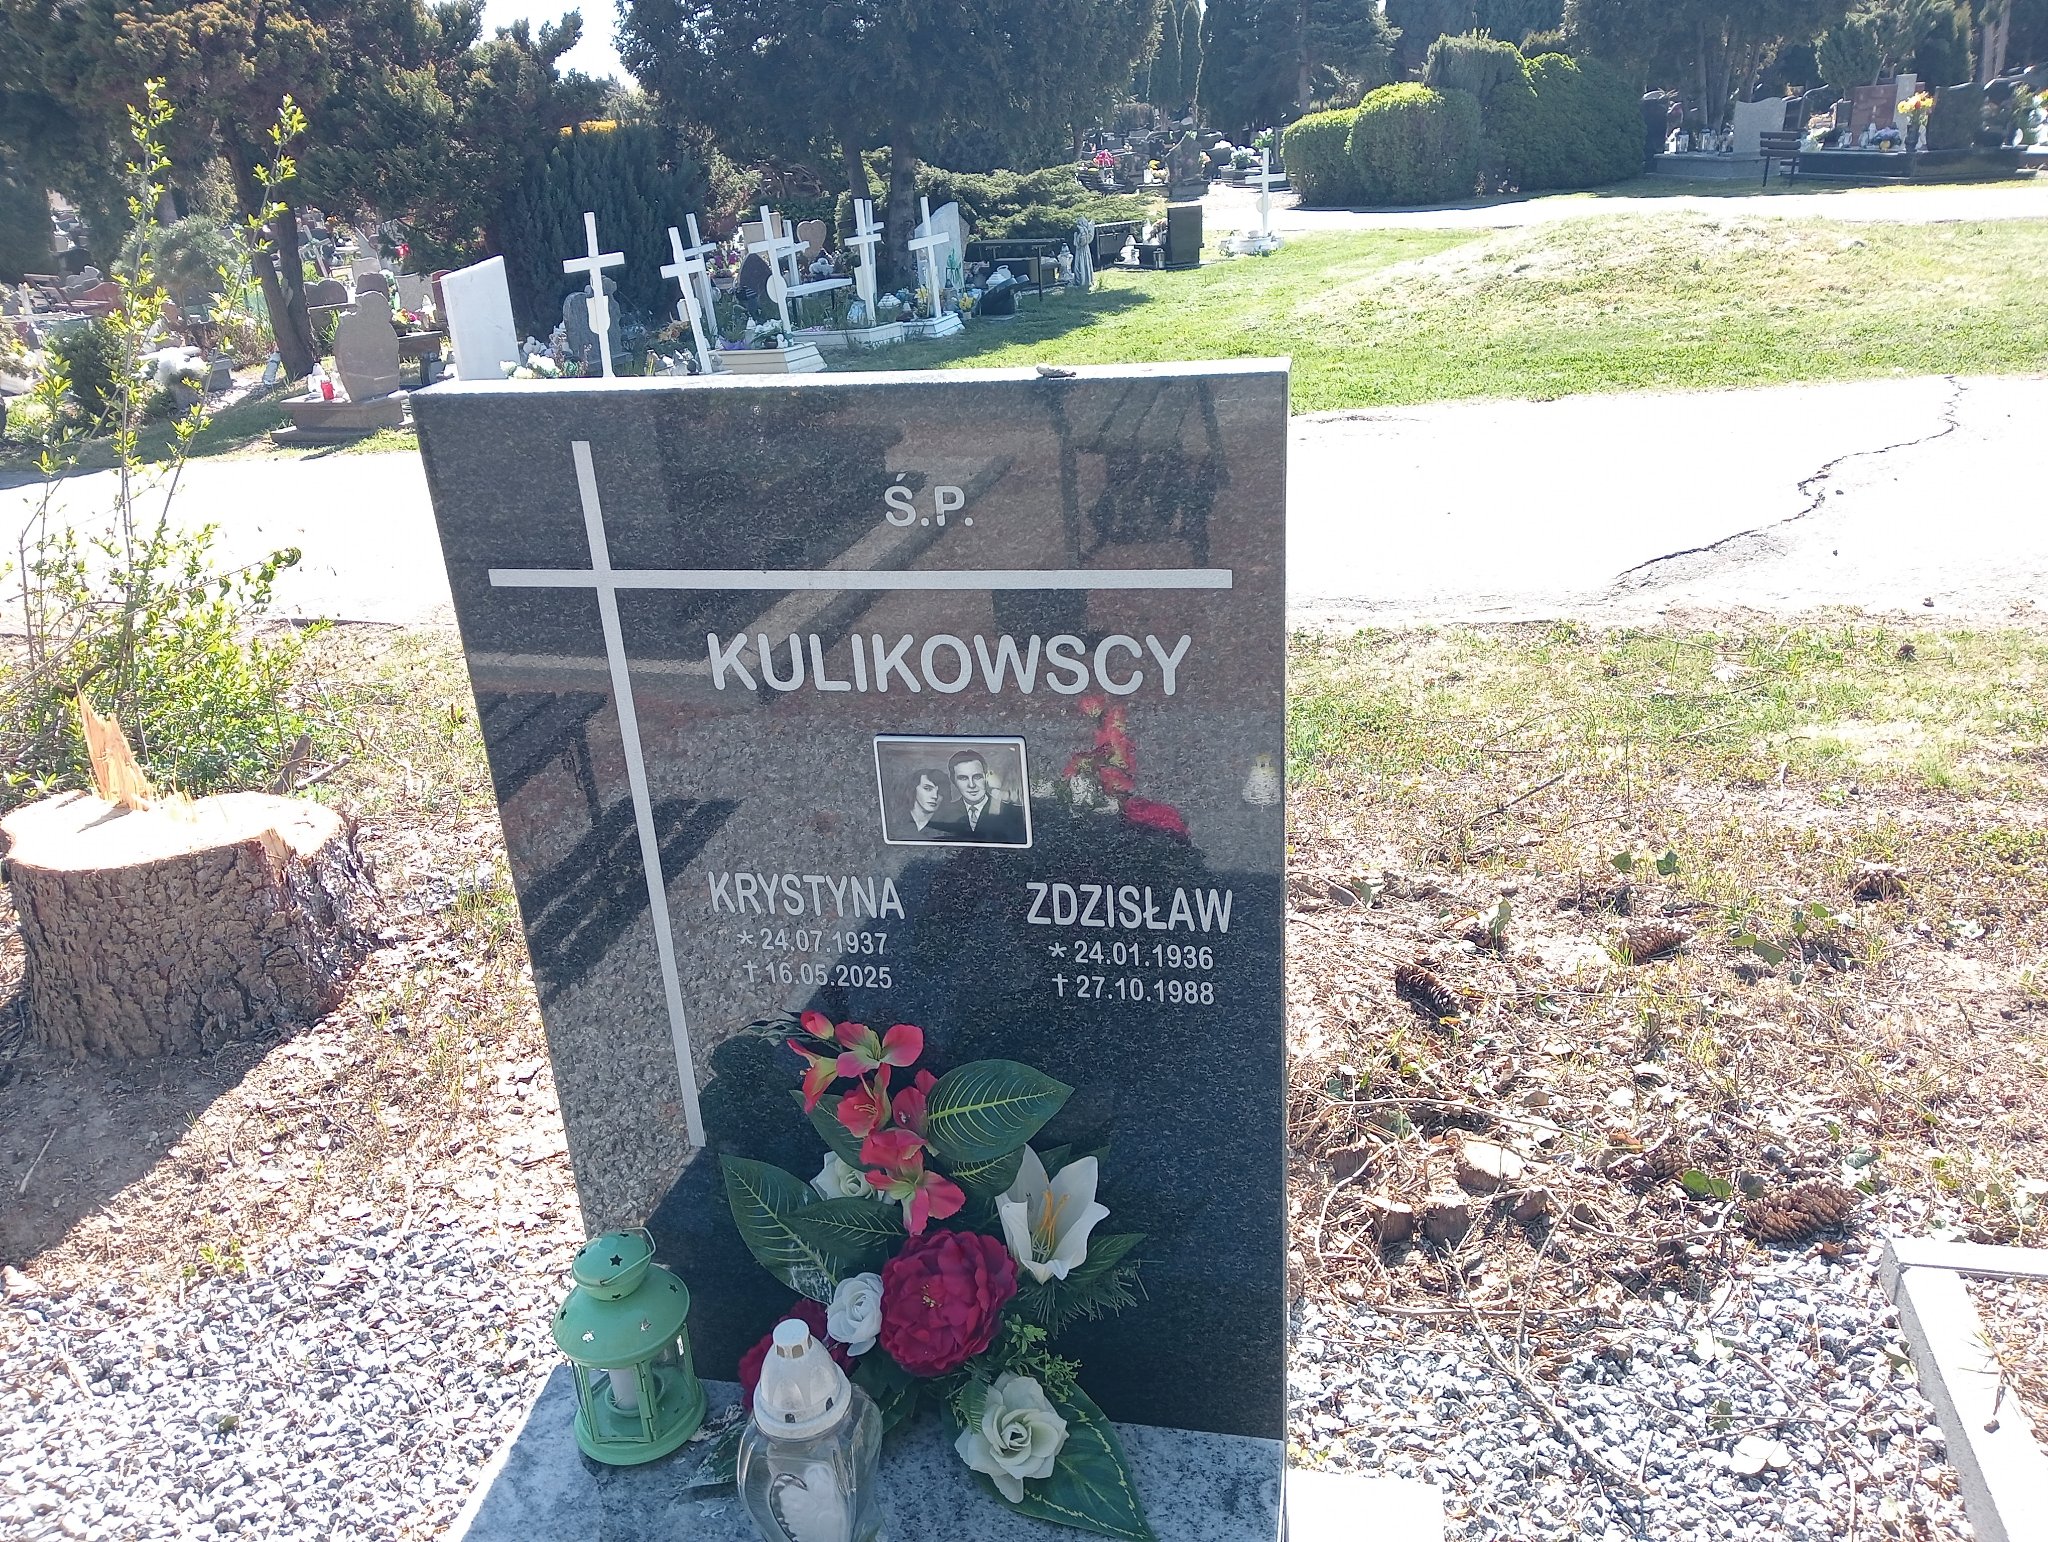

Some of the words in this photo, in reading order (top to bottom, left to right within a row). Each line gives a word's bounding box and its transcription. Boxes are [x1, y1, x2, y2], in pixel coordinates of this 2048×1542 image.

[884, 472, 974, 527] Ś.P.
[706, 632, 1192, 695] KULIKOWSCY
[708, 871, 905, 919] KRYSTYNA
[1026, 882, 1233, 933] ZDZISŁAW
[760, 928, 888, 955] 24.07.1937
[1074, 940, 1214, 970] 24.01.1936
[765, 962, 893, 989] 16.05.2025
[1076, 975, 1215, 1005] 27.10.1988
